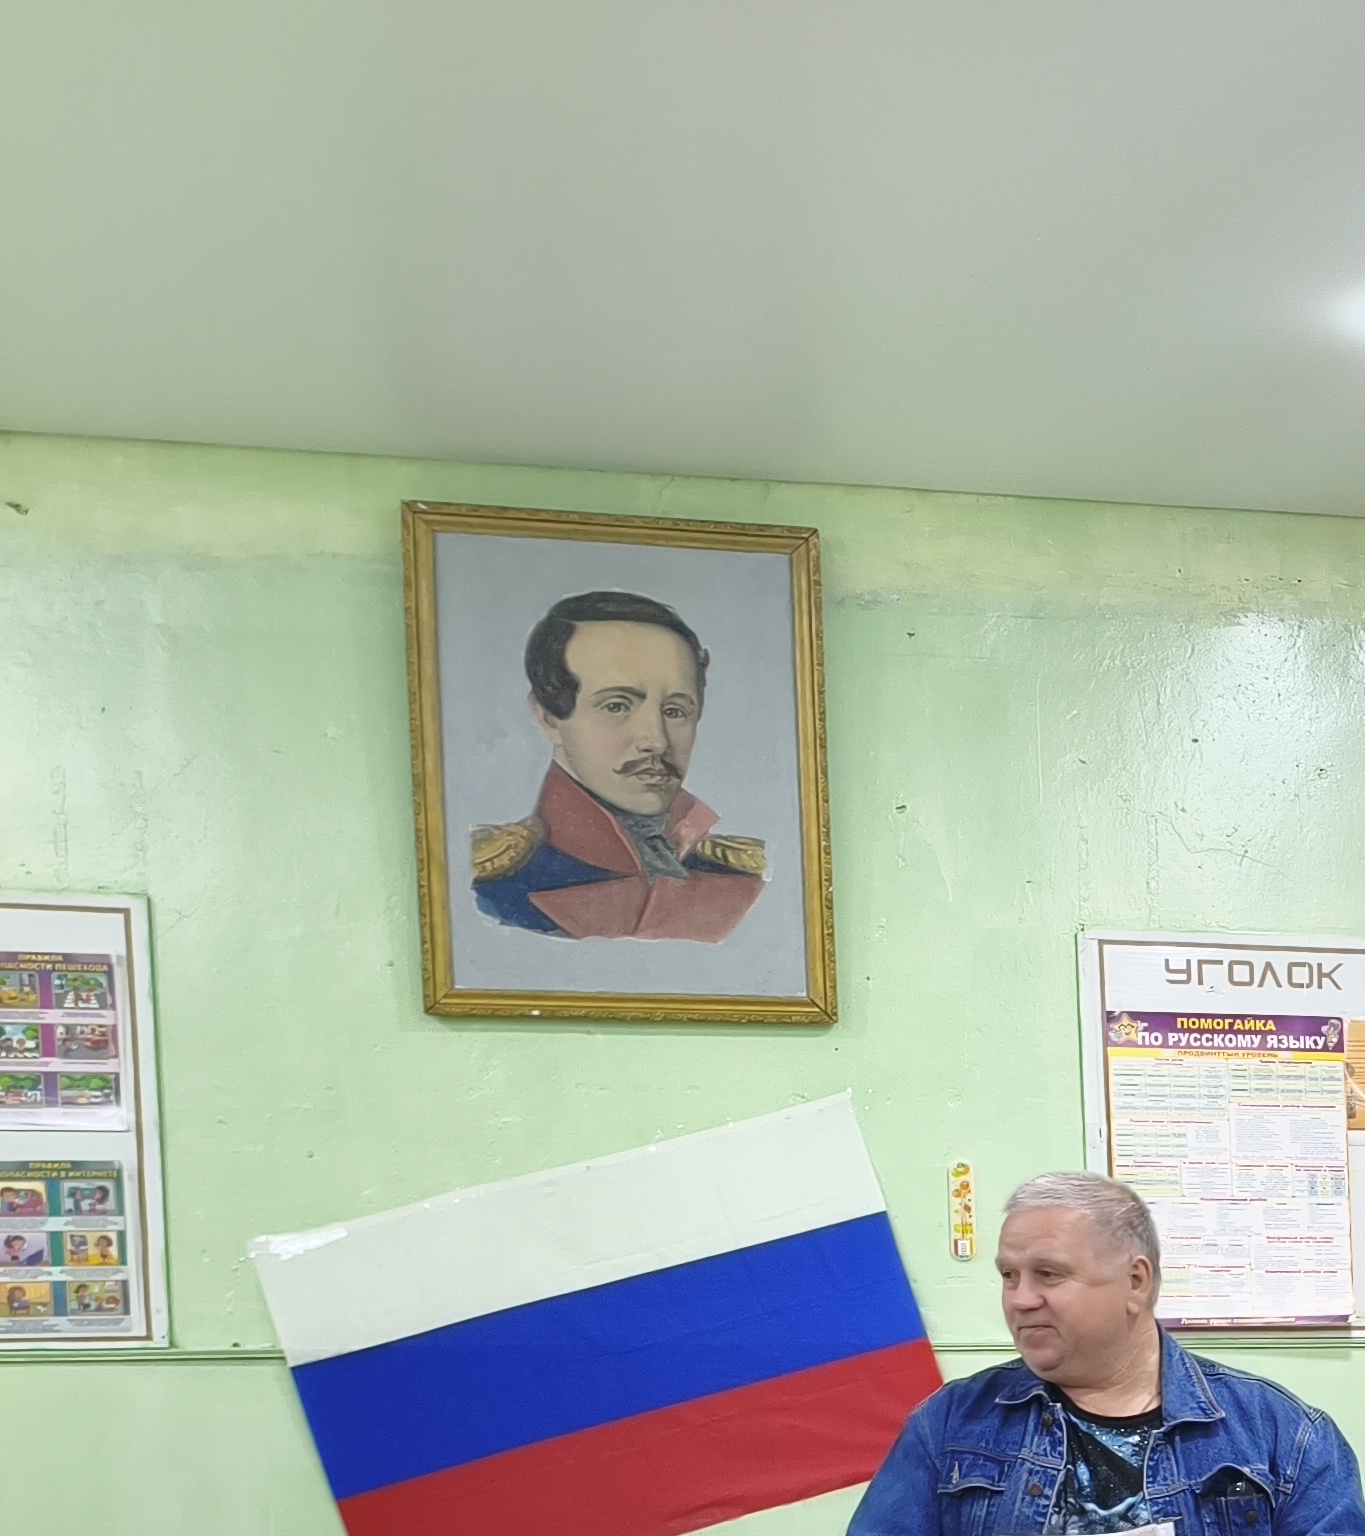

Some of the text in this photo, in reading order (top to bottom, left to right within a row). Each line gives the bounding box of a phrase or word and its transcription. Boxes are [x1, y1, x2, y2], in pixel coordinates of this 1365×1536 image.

[1163, 957, 1344, 991] УГОЛОК
[1176, 1016, 1276, 1031] ПОМОГАЙКА
[1137, 1031, 1326, 1050] ПО РУССКОМУ ЯЗЫКУ
